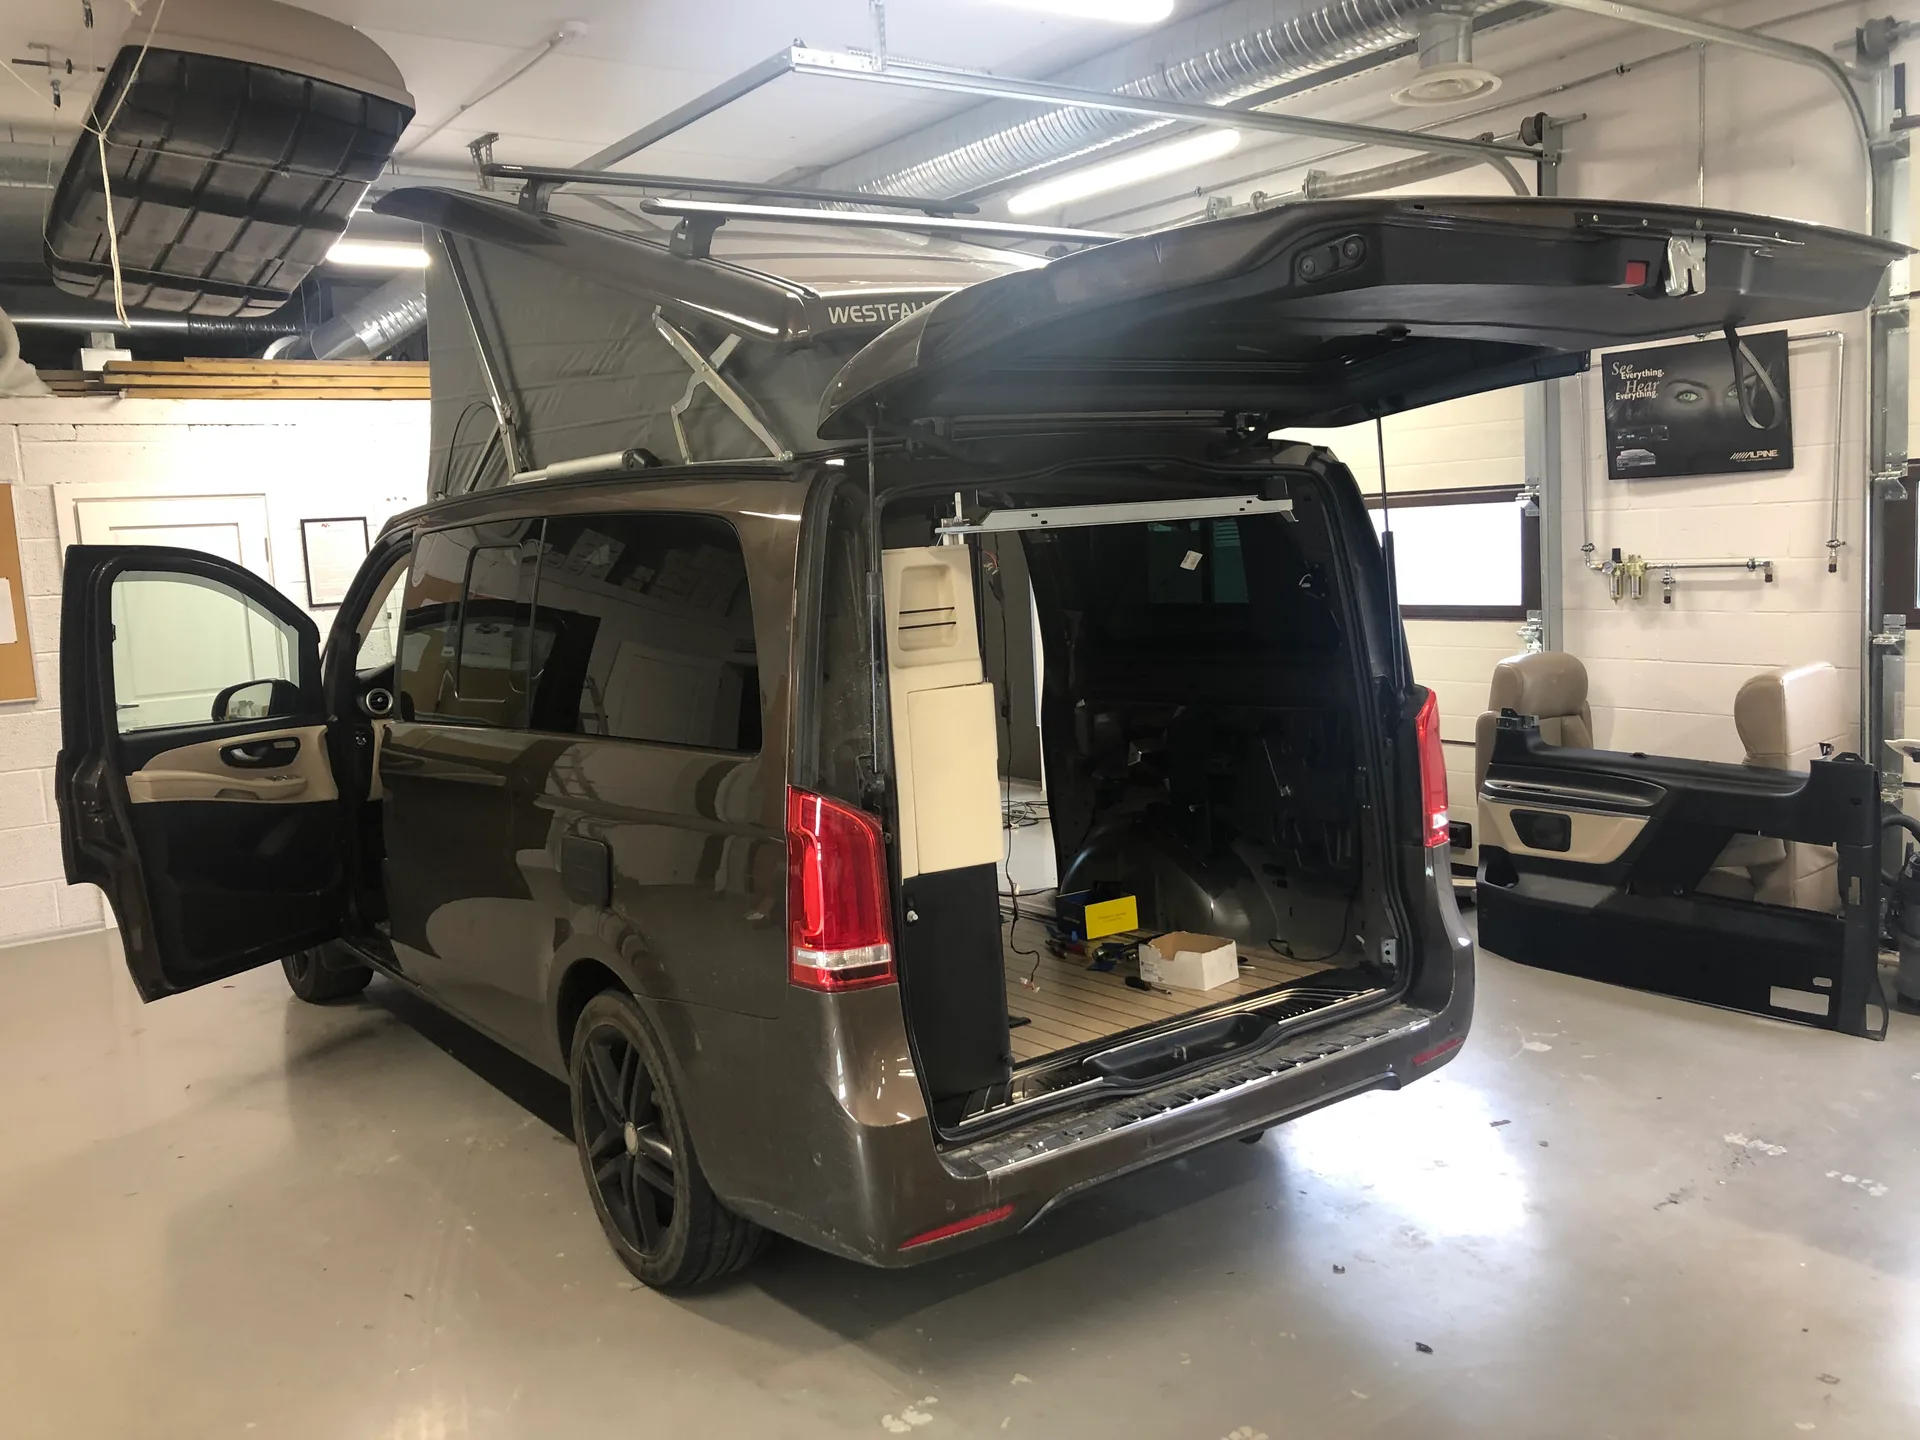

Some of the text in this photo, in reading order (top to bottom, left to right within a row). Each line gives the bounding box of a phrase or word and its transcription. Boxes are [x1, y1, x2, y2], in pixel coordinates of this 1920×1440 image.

[1612, 361, 1633, 375] See
[1621, 368, 1665, 380] Everything.
[1625, 380, 1660, 393] Hear
[1615, 390, 1659, 401] Everything.
[1743, 449, 1779, 459] ALPINE
